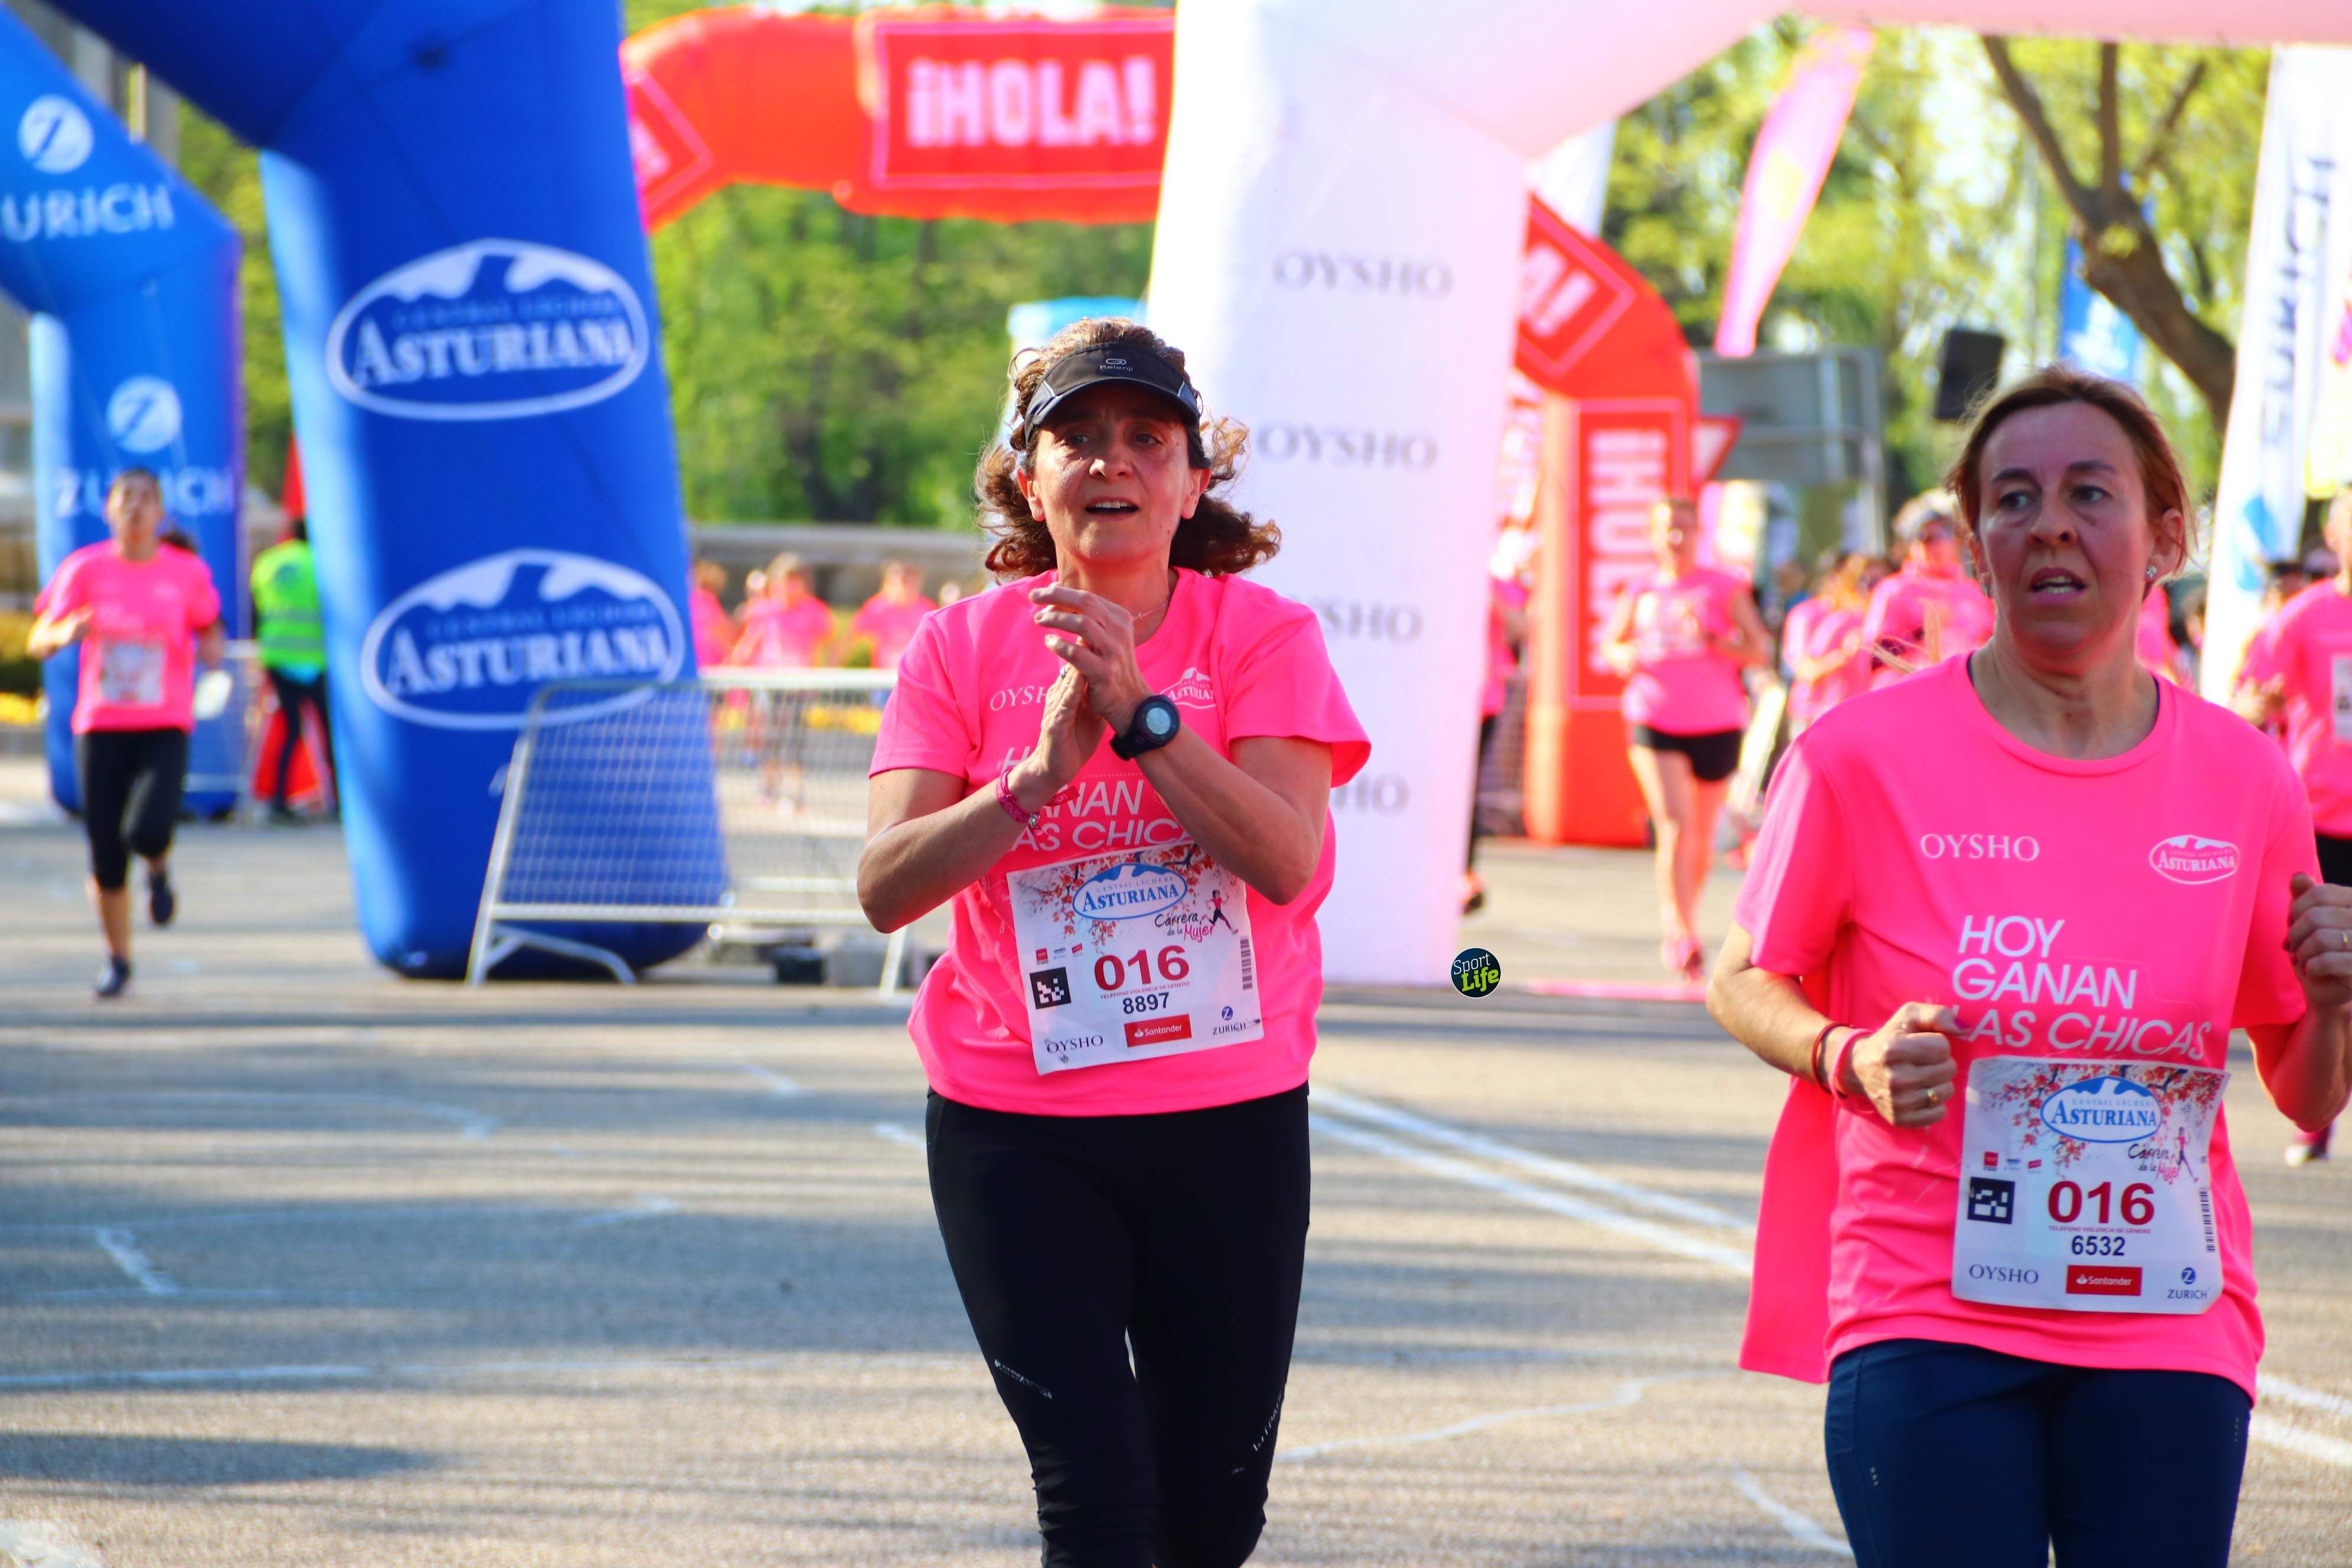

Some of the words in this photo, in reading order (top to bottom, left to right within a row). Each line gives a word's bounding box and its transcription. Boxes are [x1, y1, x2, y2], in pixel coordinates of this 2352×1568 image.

[905, 55, 1156, 148] ¡HOLA!
[0, 182, 175, 243] URICH
[1273, 250, 1454, 302] OYSHO
[355, 318, 635, 386] ASTURIANA
[1257, 423, 1439, 473] OYSHO
[56, 466, 234, 516] ZUICH
[1304, 596, 1424, 645] SHO
[387, 627, 672, 697] ASTURIANA
[990, 685, 1046, 711] OYSH
[1041, 780, 1144, 818] NAN
[1008, 823, 1061, 852] AS
[1072, 818, 1190, 850] CHIC
[1920, 834, 2039, 861] OYSHO
[2158, 850, 2236, 871] ASTURIANA
[1082, 883, 1180, 912] ASTURIANA
[1155, 913, 1198, 927] Carrera
[1167, 927, 1175, 936] de
[1177, 926, 1183, 935] la
[1184, 920, 1214, 943] Mujer
[1958, 915, 2065, 958] HOY
[1094, 945, 1190, 991] 016
[1952, 958, 2138, 1009] GANAN
[1122, 992, 1169, 1014] 8897
[1144, 1024, 1182, 1037] Santander
[1211, 1021, 1247, 1035] ZURICH
[2048, 1012, 2211, 1060] CHICAS
[1046, 1034, 1103, 1054] OYSHO
[2051, 1099, 2157, 1126] ASTURIANA
[2048, 1181, 2154, 1226] 016
[2071, 1235, 2125, 1256] 6532
[1969, 1264, 2039, 1284] OYSHO
[2088, 1276, 2132, 1286] Santander
[2168, 1289, 2207, 1299] ZURICH
